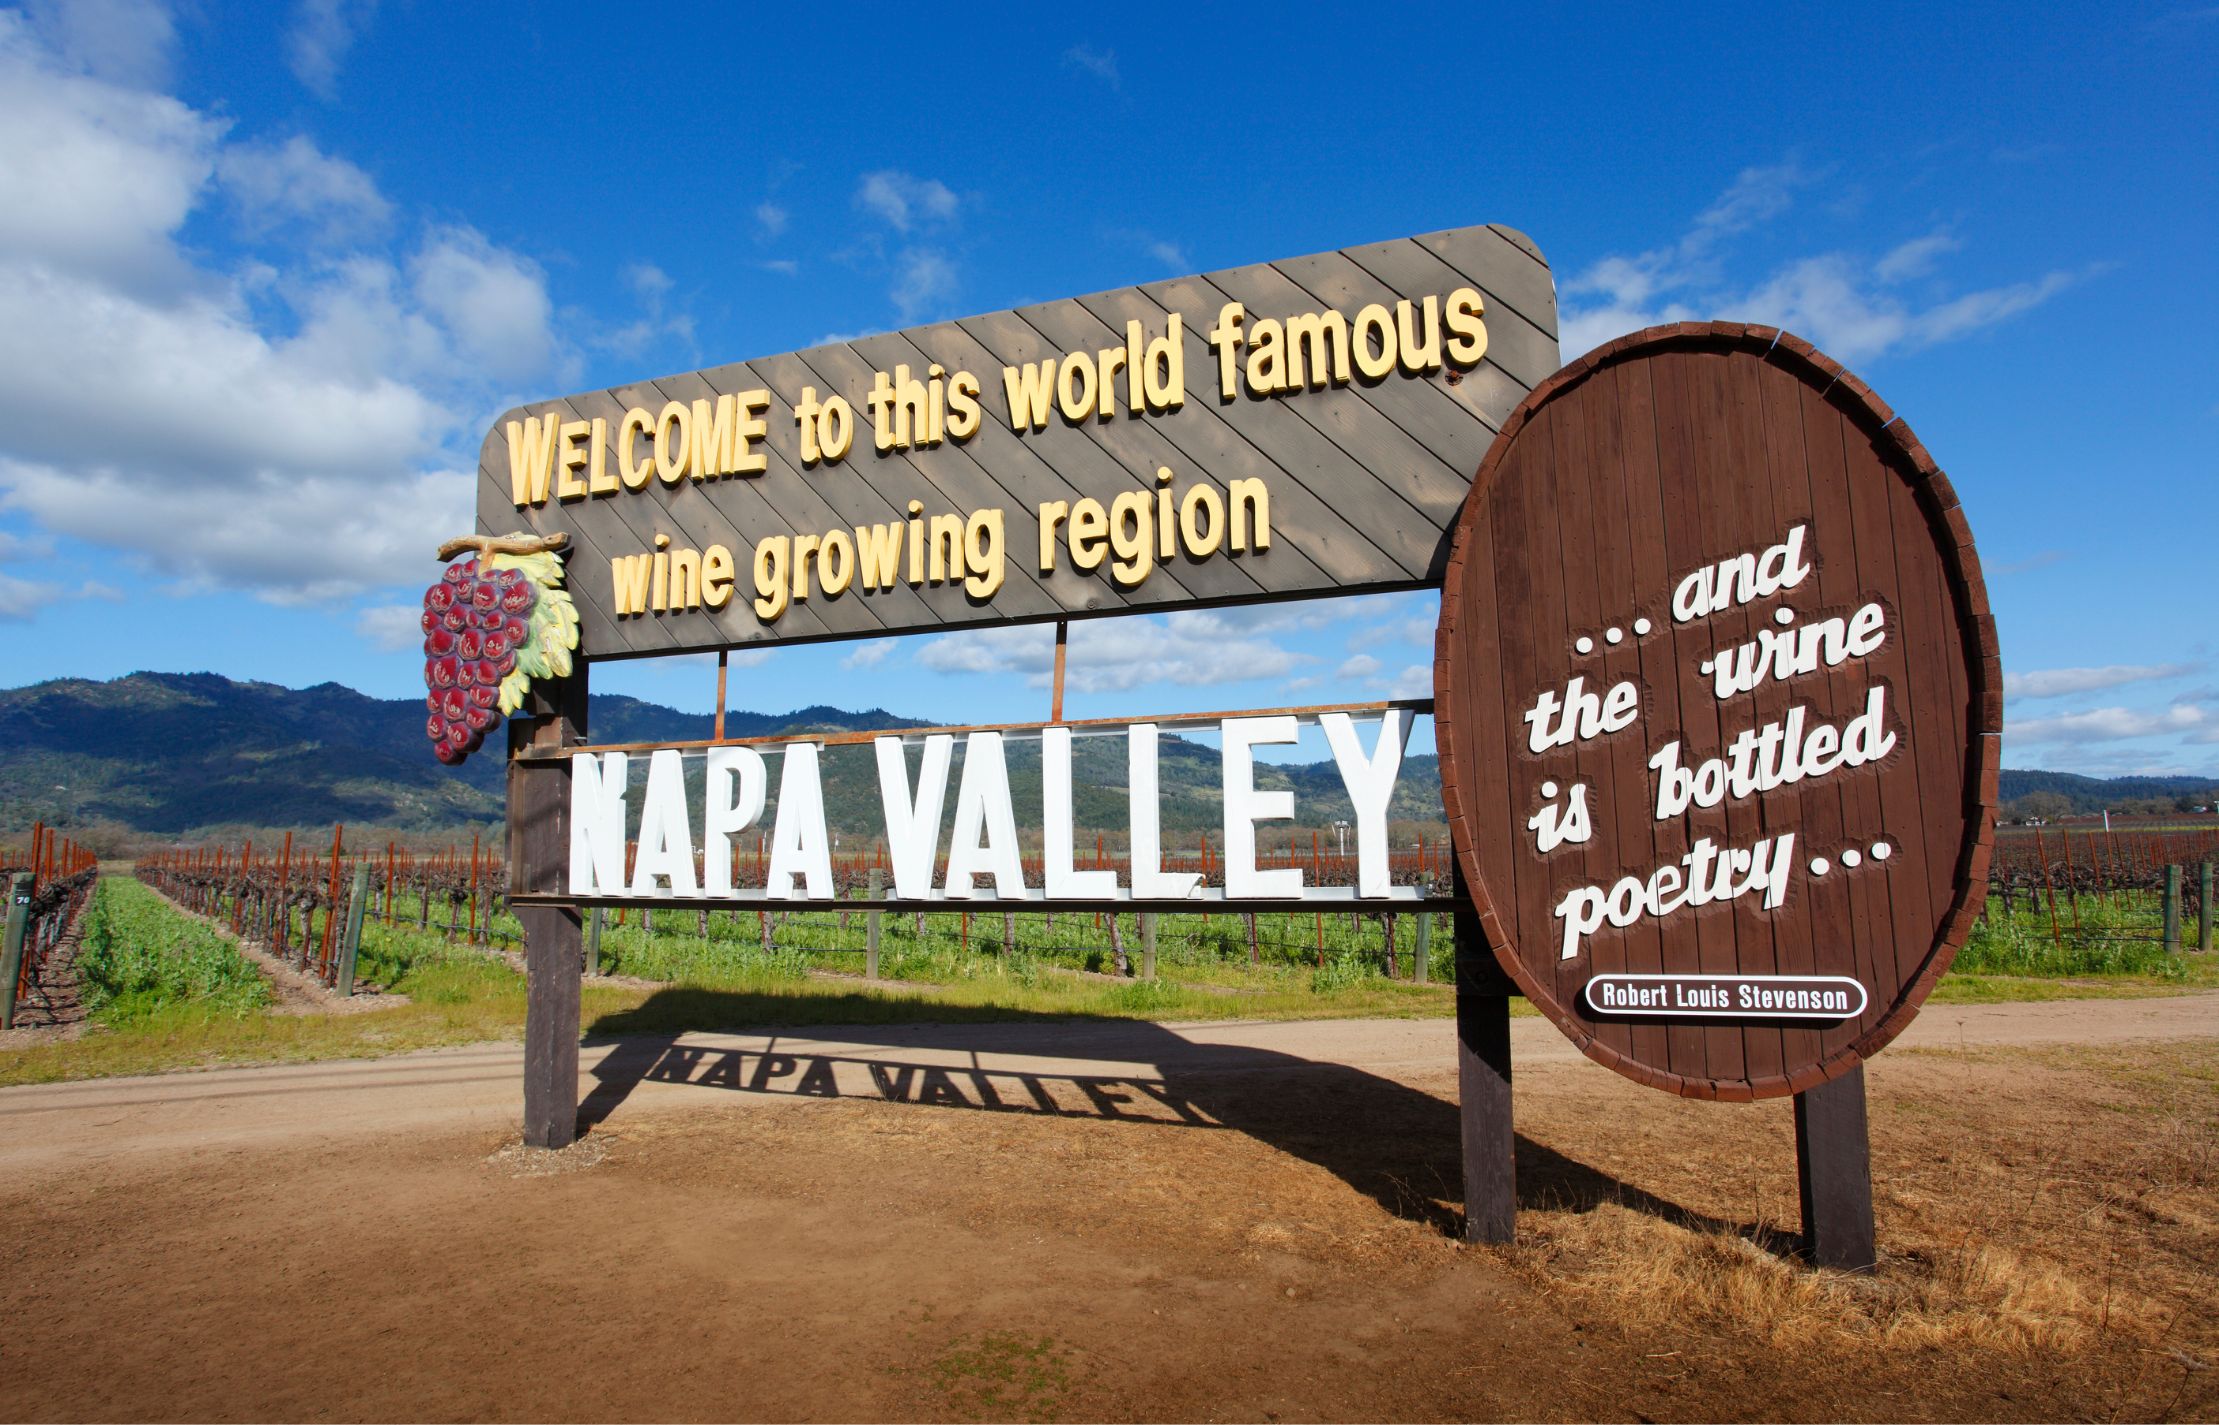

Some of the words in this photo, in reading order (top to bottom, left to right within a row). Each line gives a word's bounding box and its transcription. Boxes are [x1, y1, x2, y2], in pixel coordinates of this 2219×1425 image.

[506, 389, 771, 506] WELCOME
[795, 386, 853, 464] to
[868, 363, 981, 452] this
[1003, 313, 1184, 430] world
[1210, 288, 1488, 399] famous
[612, 534, 735, 615] wine
[754, 500, 1005, 621] growing
[1039, 467, 1271, 586] region
[1525, 676, 1638, 753] the
[1701, 603, 1886, 699] wine
[569, 742, 834, 899] NAPA
[875, 709, 1415, 900] VALLEY
[1528, 781, 1592, 852] is
[1648, 686, 1896, 820] bottled
[1603, 983, 1668, 1007] Robert
[1676, 984, 1730, 1008] Louis
[1738, 984, 1848, 1010] Stevenson
